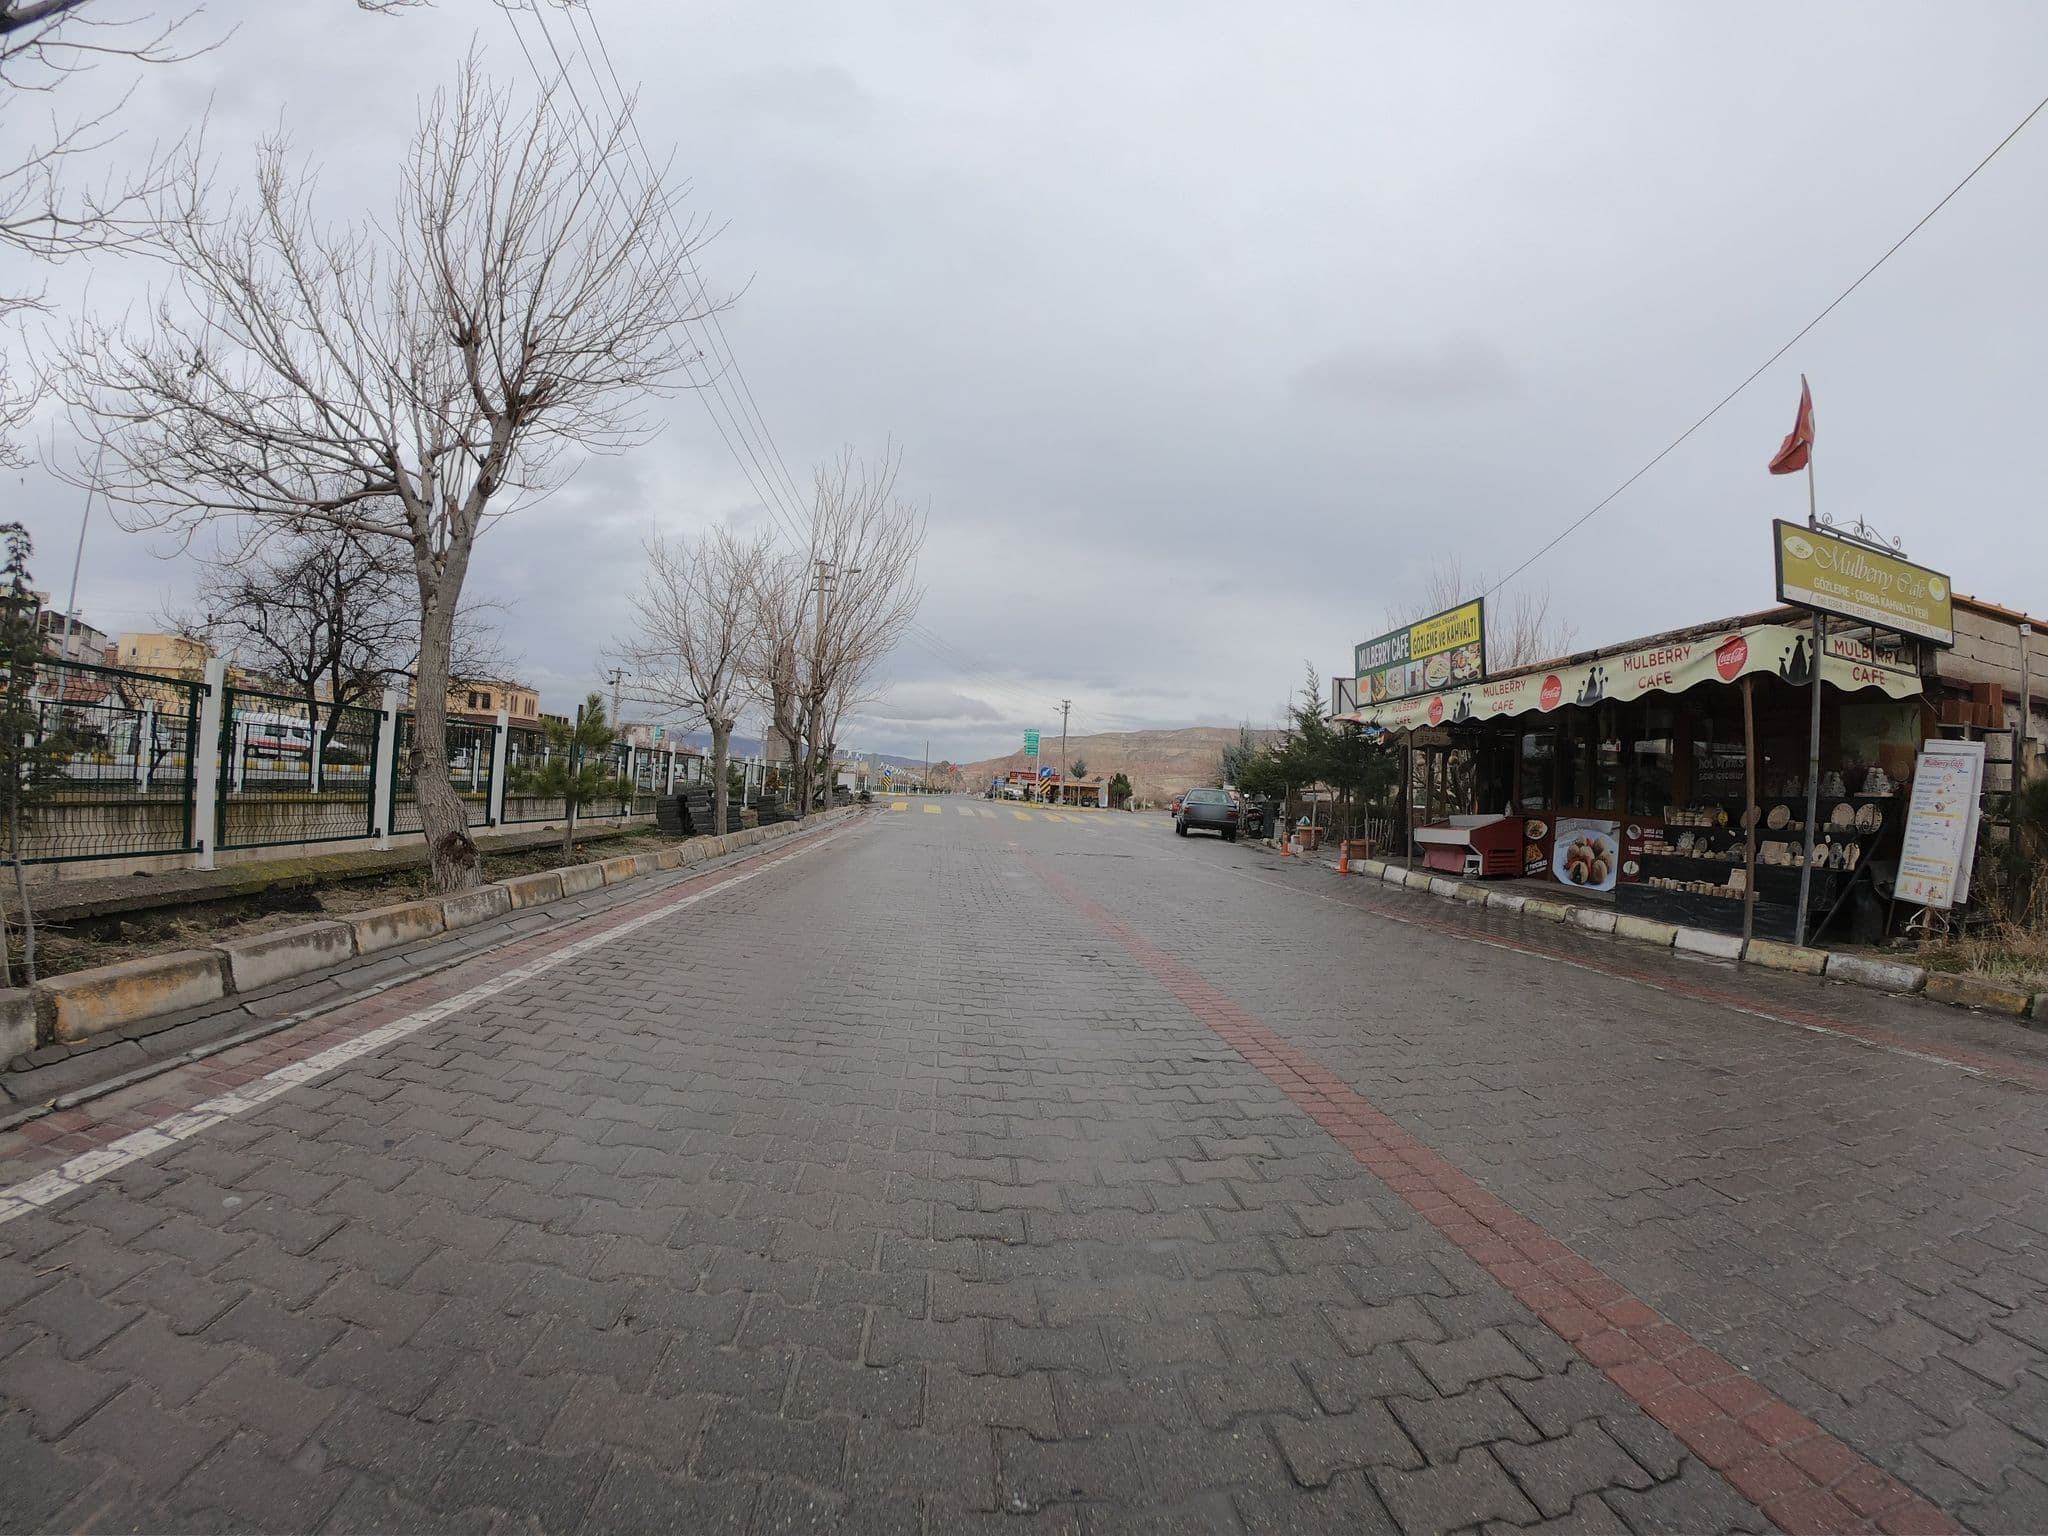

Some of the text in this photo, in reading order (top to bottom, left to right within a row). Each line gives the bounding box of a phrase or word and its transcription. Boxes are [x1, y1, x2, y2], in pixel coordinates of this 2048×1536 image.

[1814, 545, 1893, 597] Mulberry
[1813, 577, 1850, 598] GÖZLEME
[1855, 590, 1880, 606] ÇORBA
[1446, 616, 1477, 644] KAHVALTI
[1358, 633, 1410, 671] MULBERRY CAFE
[1623, 645, 1692, 673] MULBERRY
[1834, 639, 1900, 665] MULBRRY
[1483, 680, 1527, 698] MULBERRY
[1638, 671, 1673, 689] CAFE
[1852, 667, 1886, 685] CAFE
[1491, 700, 1514, 712] CAFE
